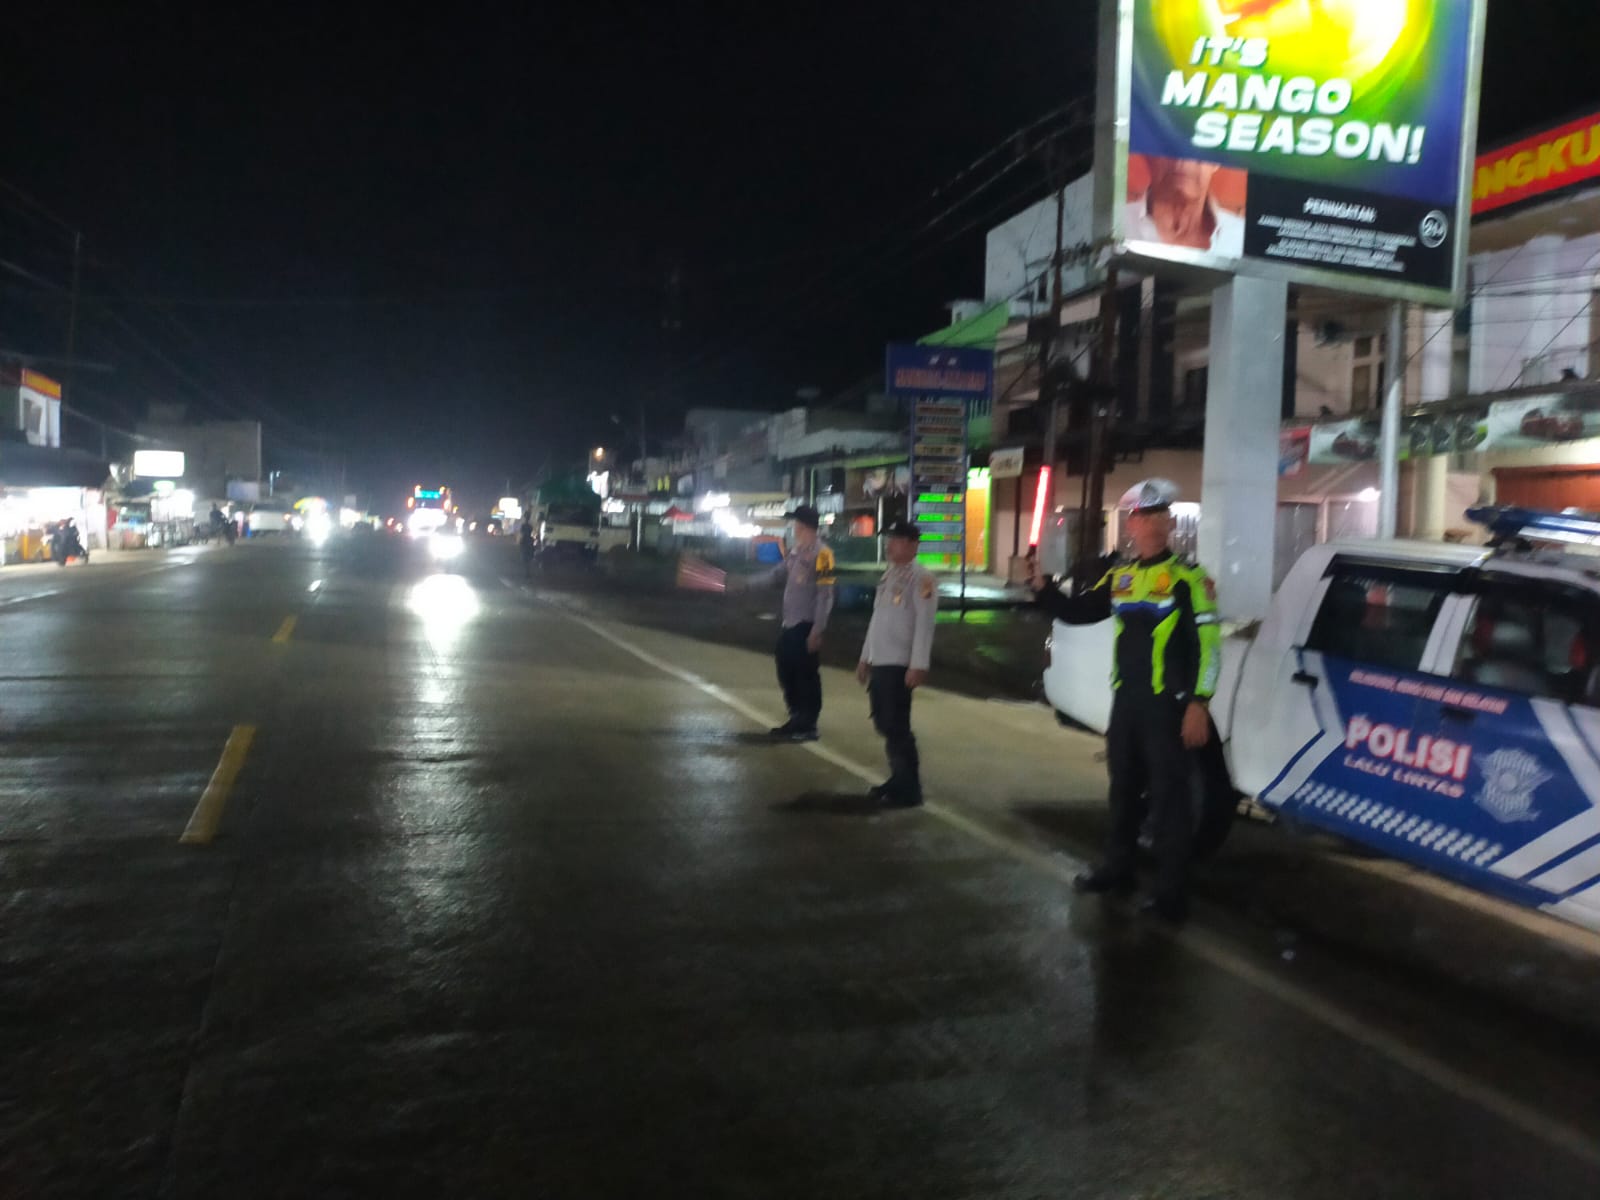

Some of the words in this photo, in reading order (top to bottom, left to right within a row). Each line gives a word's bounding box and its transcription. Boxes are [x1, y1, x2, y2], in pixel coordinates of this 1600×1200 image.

[1190, 36, 1268, 68] IT'S
[1161, 70, 1352, 115] MANGO
[1191, 111, 1426, 164] SEASON!
[1343, 755, 1391, 777] LALU
[1345, 715, 1472, 781] POLISI
